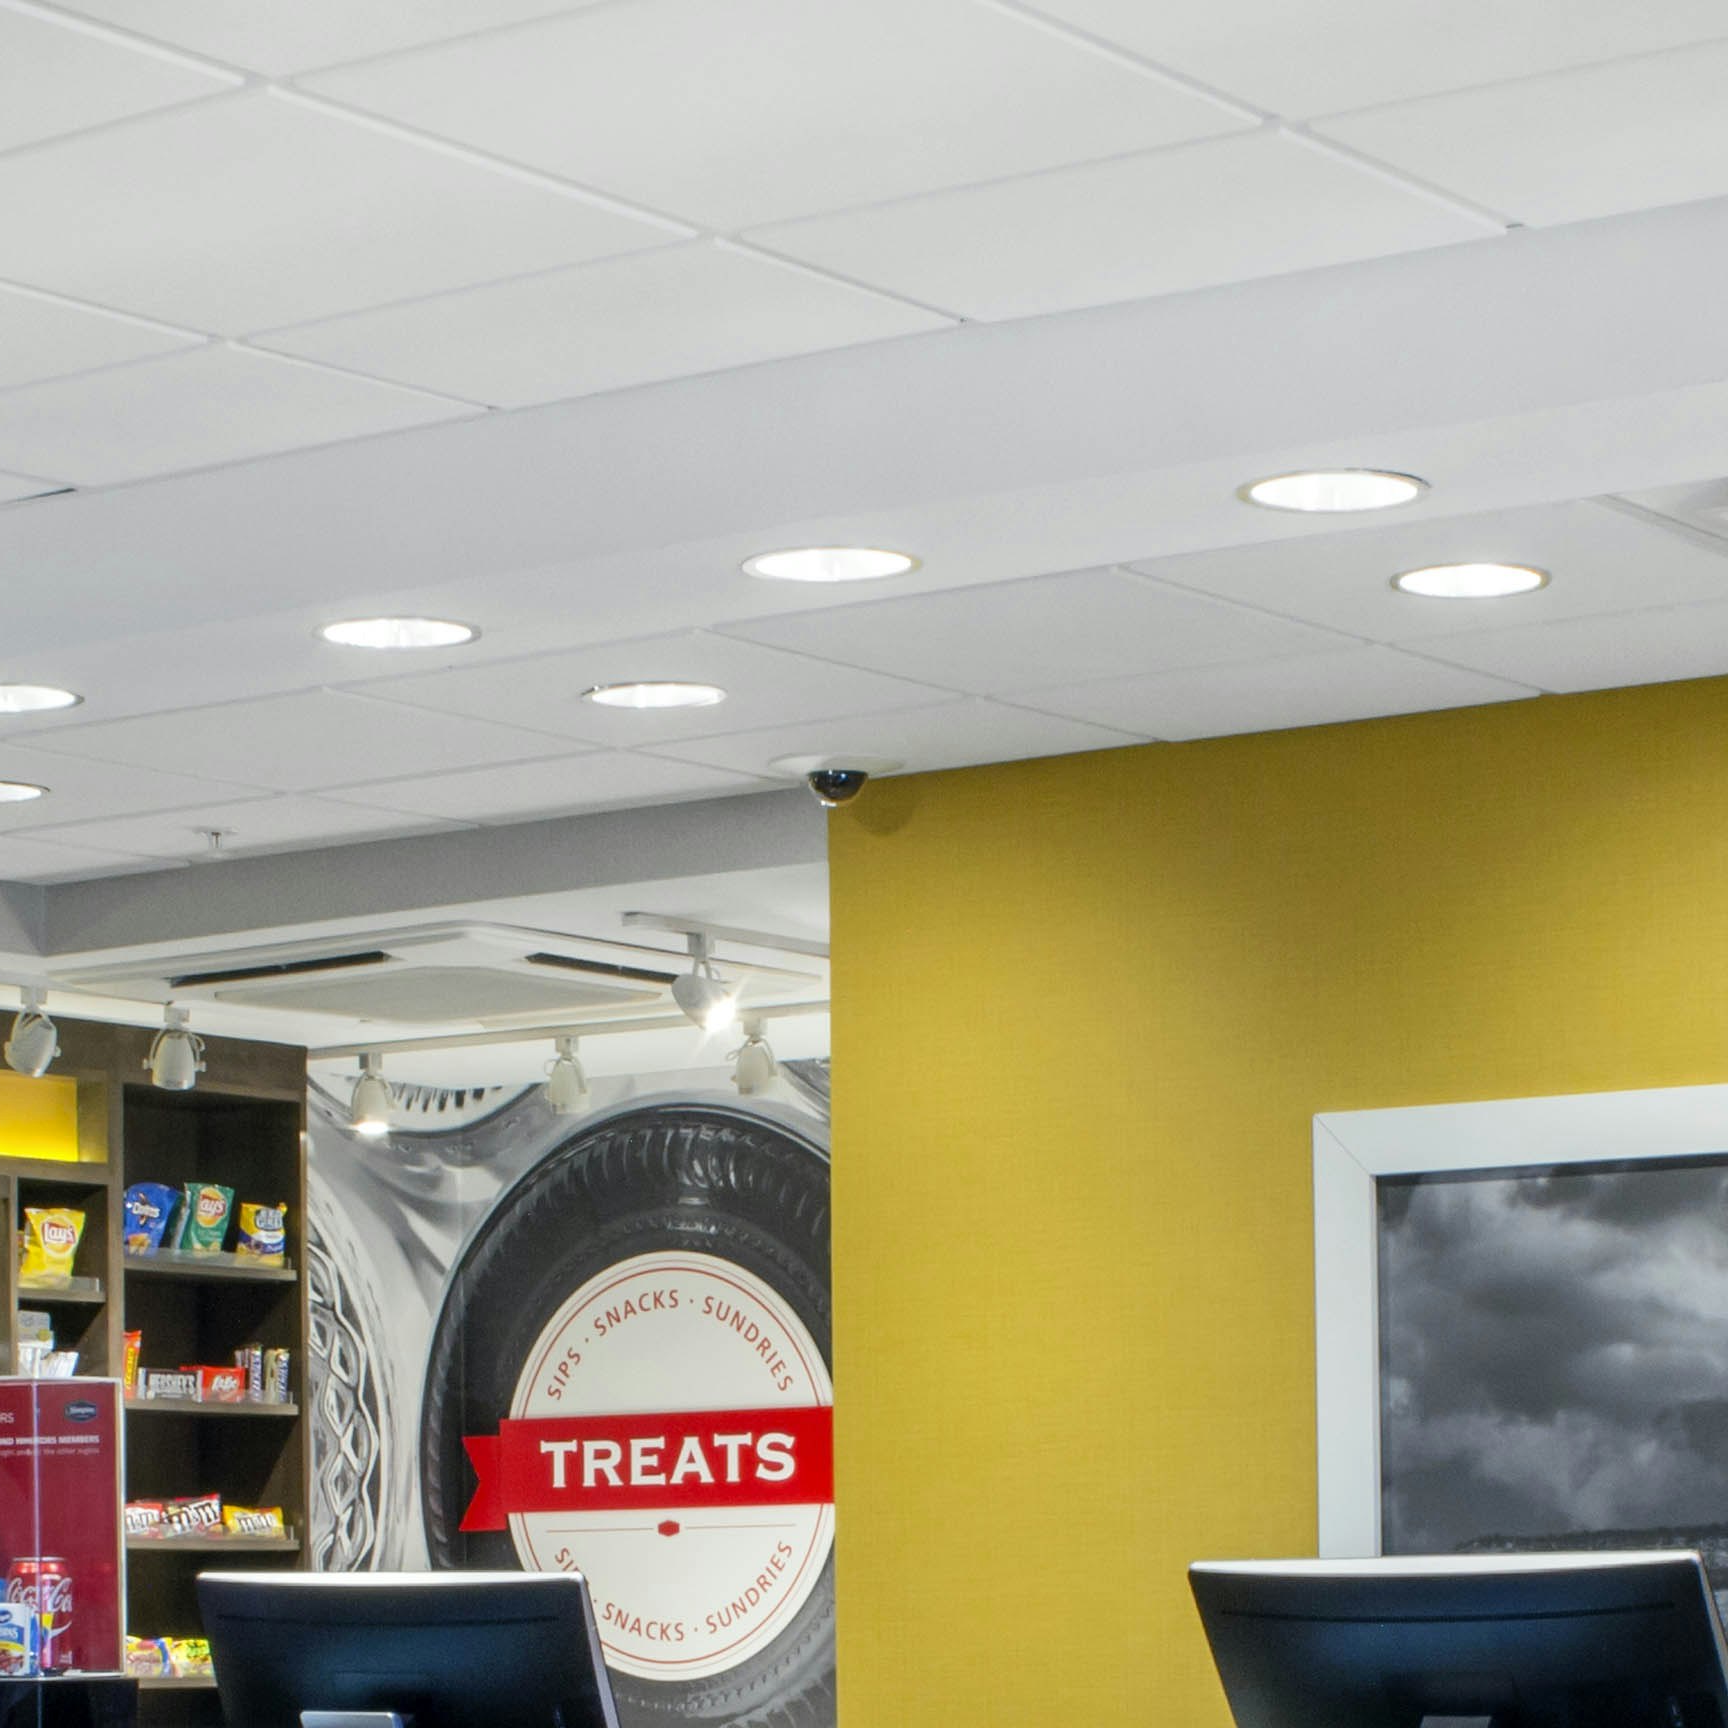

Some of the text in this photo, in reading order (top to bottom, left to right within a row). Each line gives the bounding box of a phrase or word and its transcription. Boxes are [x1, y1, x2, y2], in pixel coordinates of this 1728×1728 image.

[547, 1289, 794, 1400] SIPS SNACKS SUNDRIES
[540, 1432, 797, 1488] TREATS
[602, 1602, 685, 1641] SNACKS
[705, 1540, 793, 1634] SUNDRIES
